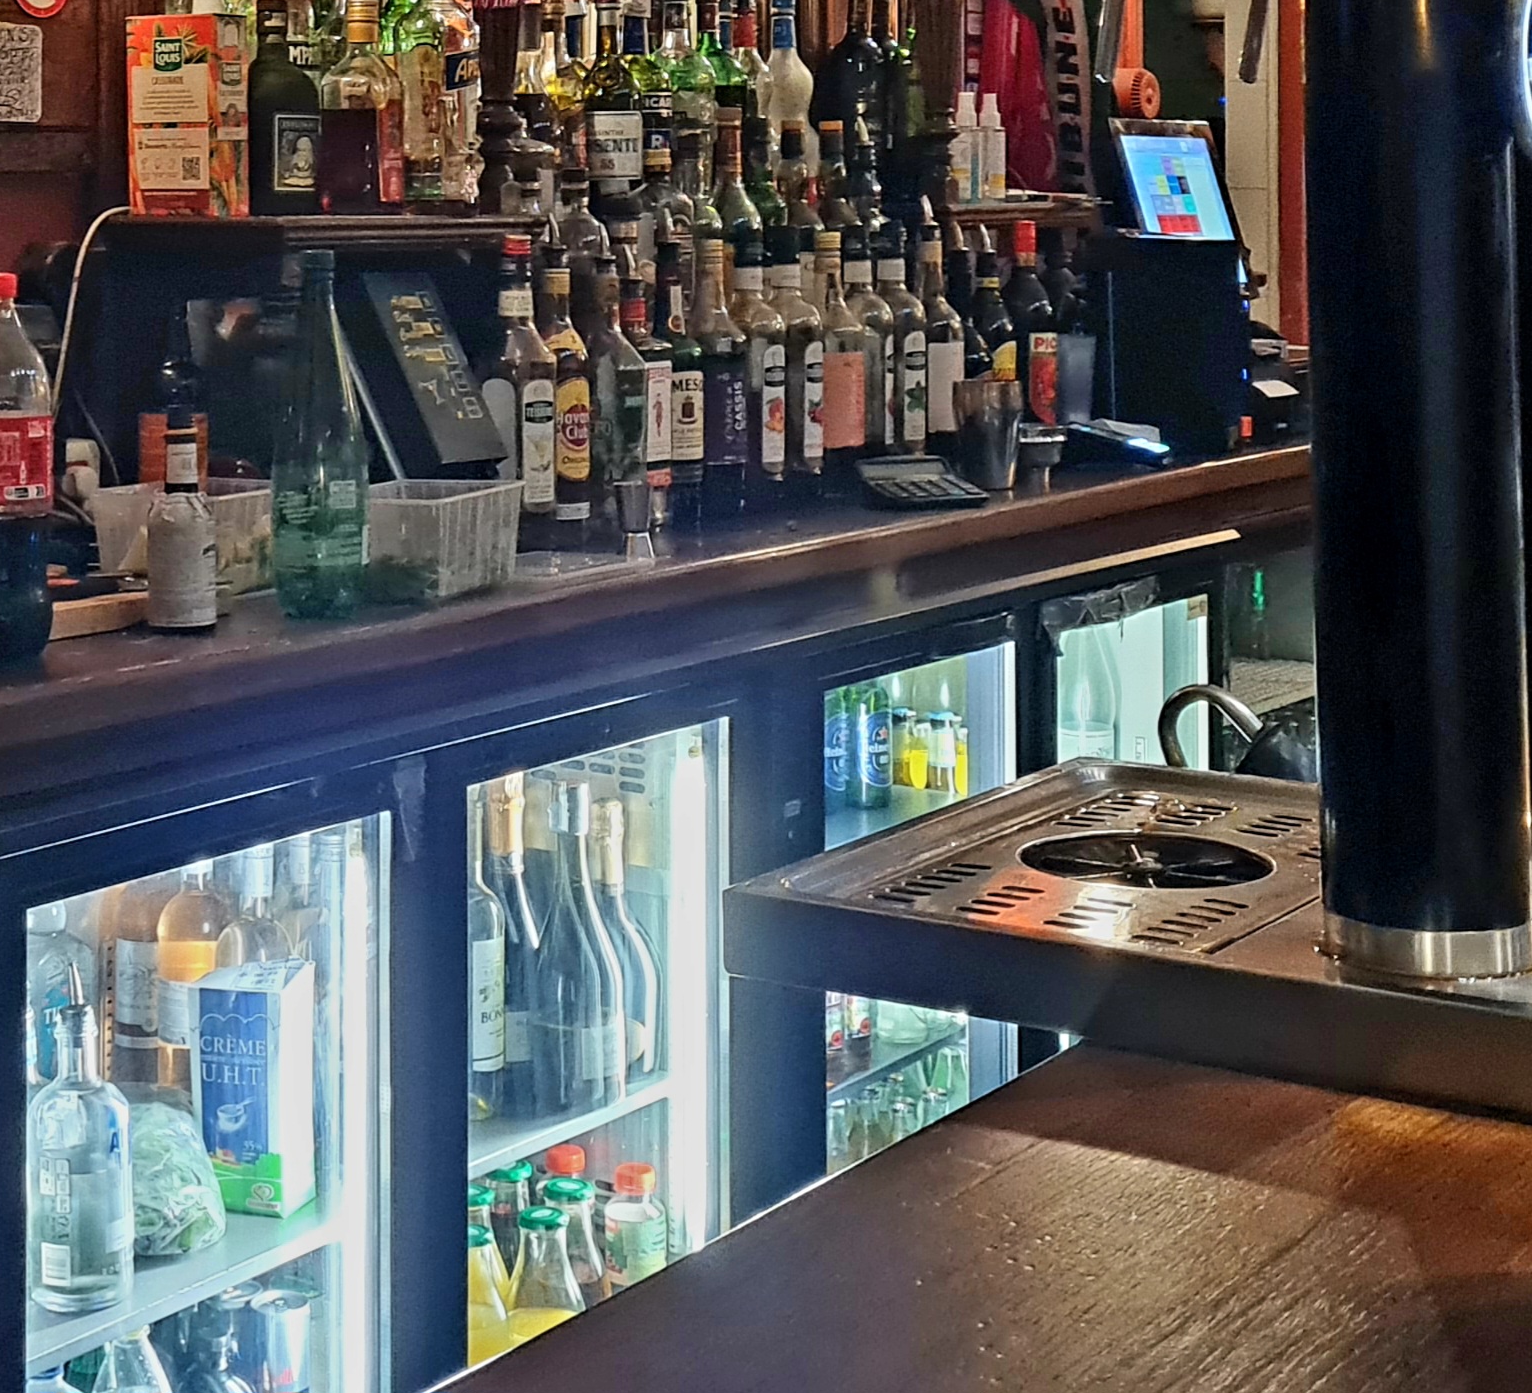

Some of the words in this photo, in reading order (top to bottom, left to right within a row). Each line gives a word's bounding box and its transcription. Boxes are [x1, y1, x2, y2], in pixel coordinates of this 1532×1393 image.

[154, 41, 181, 53] SAINT
[154, 52, 181, 67] LOUIS
[645, 96, 672, 108] ICAR
[1051, 6, 1091, 194] IBUNE
[733, 381, 744, 431] CASSIS
[199, 1033, 267, 1057] CRÈME
[201, 1062, 266, 1087] U.H.T.
